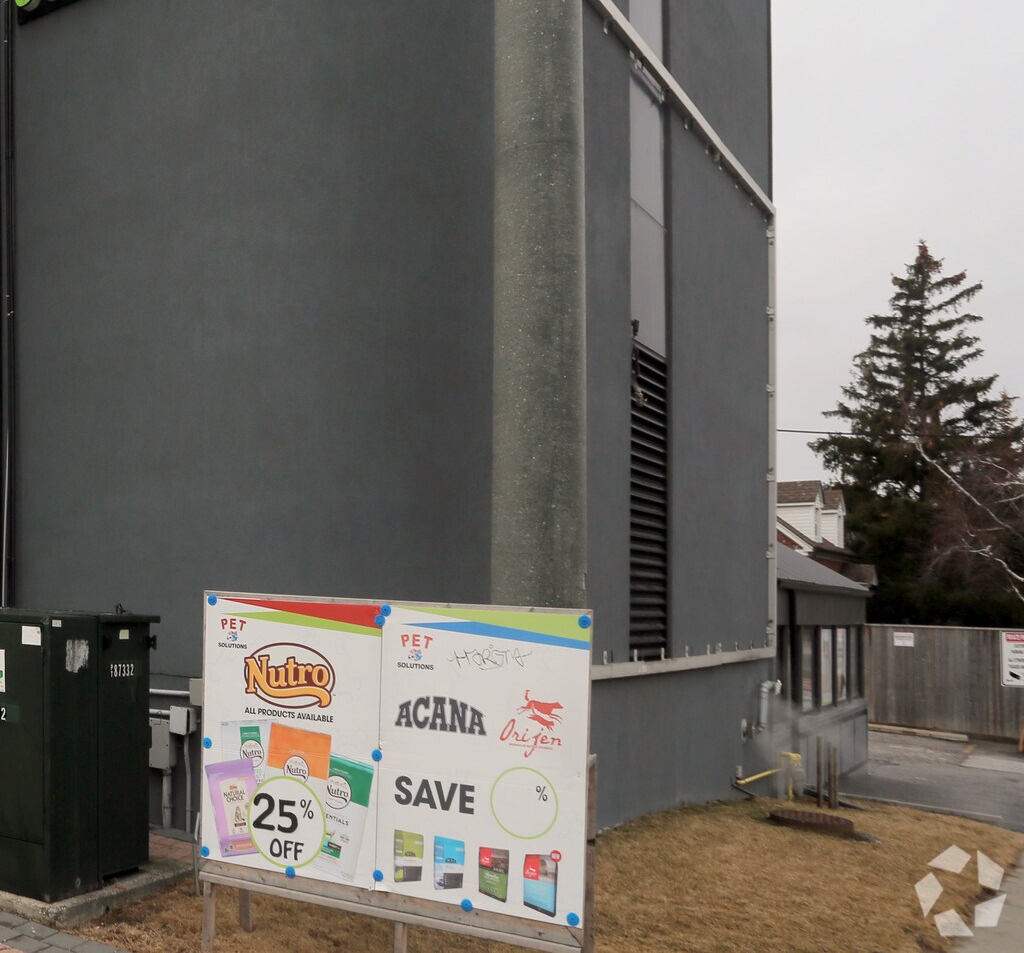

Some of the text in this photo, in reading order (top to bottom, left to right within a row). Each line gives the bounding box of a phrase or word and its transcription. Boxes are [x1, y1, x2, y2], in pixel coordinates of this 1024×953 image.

[220, 618, 246, 631] PET
[217, 642, 248, 650] SOLUTIONS
[400, 633, 433, 649] PET
[113, 663, 134, 677] 87332
[397, 662, 434, 671] SOLUTIONS
[244, 654, 331, 704] Nutro
[244, 706, 334, 723] ALL PRODUCTS AVAILABLE
[395, 695, 487, 736] ACANA
[499, 718, 563, 758] Orijen
[241, 749, 262, 759] Nutro
[286, 764, 307, 777] Nutro
[394, 775, 475, 815] SAVE
[535, 785, 548, 802] %
[252, 792, 315, 834] 25%
[269, 838, 305, 861] OFF
